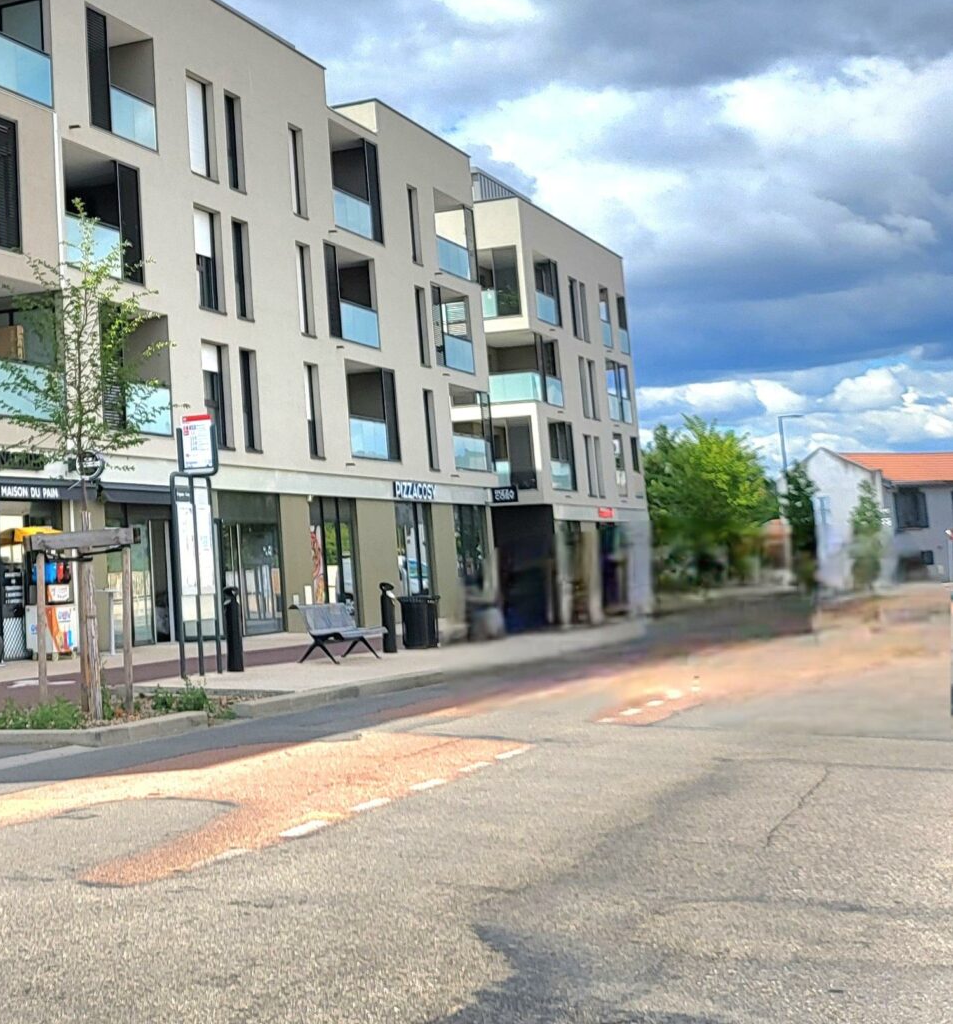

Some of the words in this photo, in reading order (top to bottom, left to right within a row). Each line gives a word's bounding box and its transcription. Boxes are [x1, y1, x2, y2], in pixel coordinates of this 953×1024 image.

[1, 486, 28, 498] MAISON
[30, 487, 41, 498] DU
[43, 487, 59, 499] PAIN
